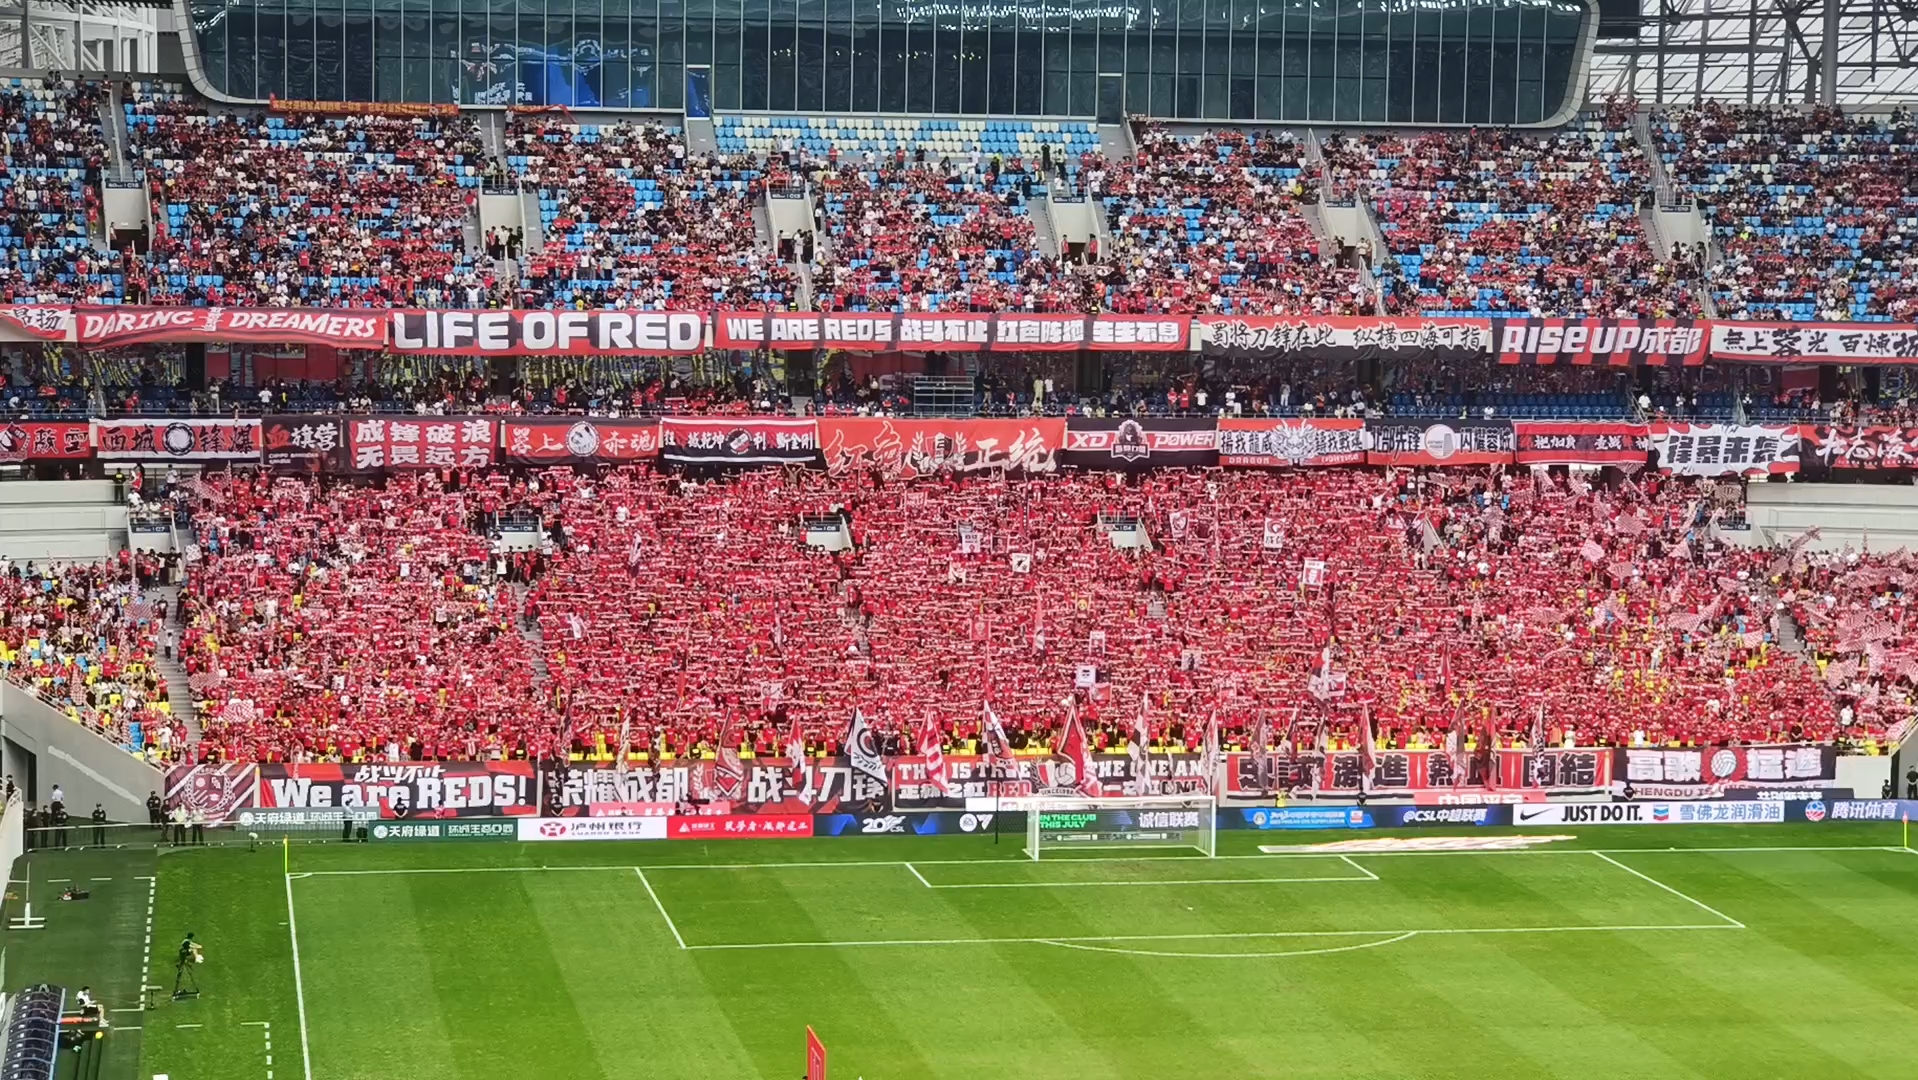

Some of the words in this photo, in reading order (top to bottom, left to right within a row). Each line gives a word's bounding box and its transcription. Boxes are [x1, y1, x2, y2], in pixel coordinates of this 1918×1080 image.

[13, 309, 62, 331] 昂扬
[83, 311, 195, 338] DARING
[229, 312, 377, 338] DREAMERS
[394, 311, 509, 350] LIFE
[522, 311, 589, 350] OF
[599, 313, 701, 350] RED
[727, 318, 764, 341] WE
[771, 319, 820, 341] ARE
[824, 319, 892, 342] REDS
[900, 318, 988, 342] 战斗不止
[997, 319, 1084, 343] 红色阵地
[1093, 320, 1179, 343] 生生不息
[1211, 322, 1335, 350] 蜀将刀锋在此
[1354, 322, 1481, 349] 纵横四海可指
[266, 422, 338, 451] 血旗营
[1070, 433, 1108, 449] XD
[1154, 432, 1215, 449] POWER
[1372, 426, 1421, 459] 北部先锋
[356, 445, 490, 469] 无畏远方
[963, 427, 1057, 474] 正统
[1229, 457, 1269, 465] DRAGON
[952, 762, 971, 780] IS
[271, 778, 331, 808] We
[341, 784, 411, 809] are
[417, 774, 526, 809] REDS!
[987, 780, 1031, 799] RED
[1633, 787, 1693, 798] HENGDU
[255, 811, 305, 825] 天府绿道
[310, 811, 377, 822] 环城生公园
[1070, 813, 1097, 821] CLUB
[1139, 811, 1199, 829] 诚信联赛
[1561, 805, 1595, 823] JUST
[1597, 805, 1624, 822] DO
[1627, 804, 1643, 821] IT.
[1680, 803, 1780, 821] 雪佛龙润滑油
[1831, 802, 1897, 820] 腾讯体育
[389, 825, 440, 837] 天府绿道
[1039, 821, 1061, 829] THIS
